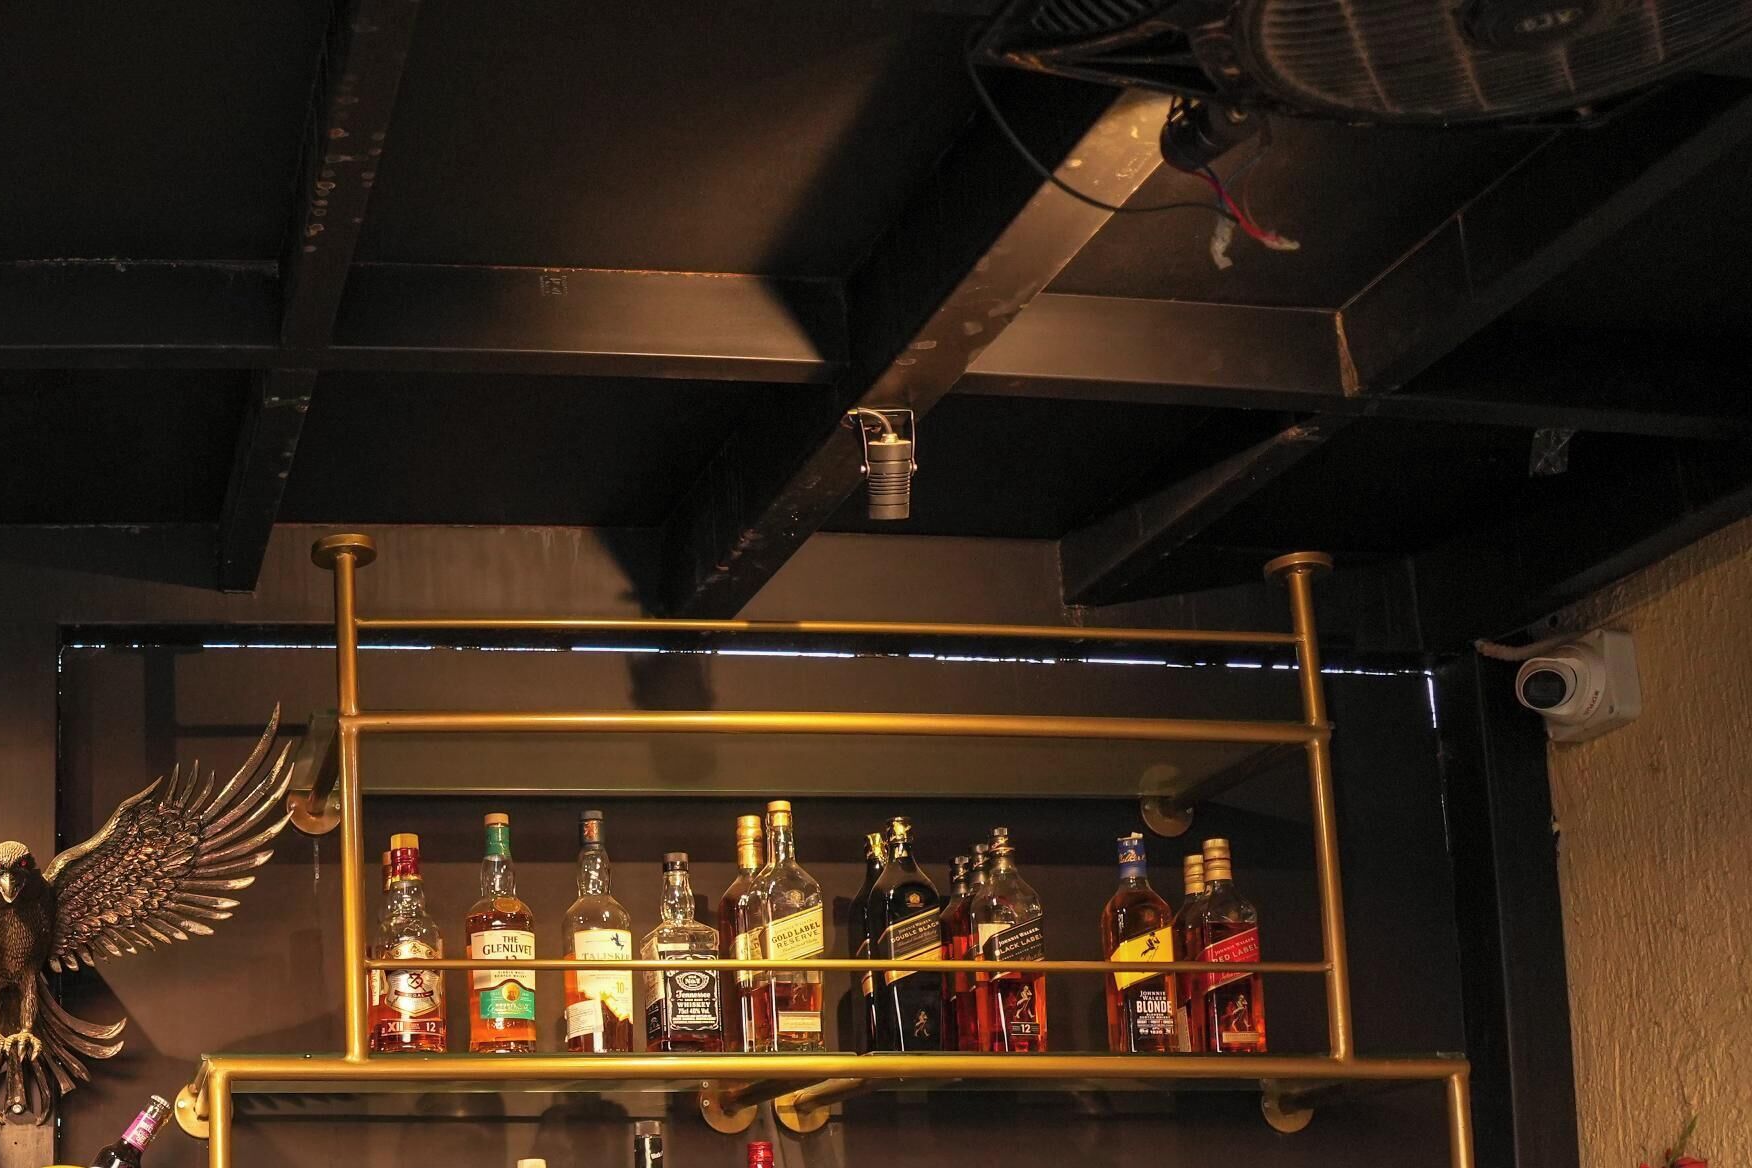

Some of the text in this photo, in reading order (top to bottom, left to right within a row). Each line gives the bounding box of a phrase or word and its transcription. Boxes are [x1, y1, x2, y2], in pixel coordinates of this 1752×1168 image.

[772, 921, 821, 944] GOLD LABEL
[777, 931, 820, 949] RESERVE
[482, 945, 533, 955] GLENLIVET
[1136, 1000, 1172, 1014] BLONDE
[425, 1021, 436, 1033] 12
[1020, 1024, 1031, 1034] 12
